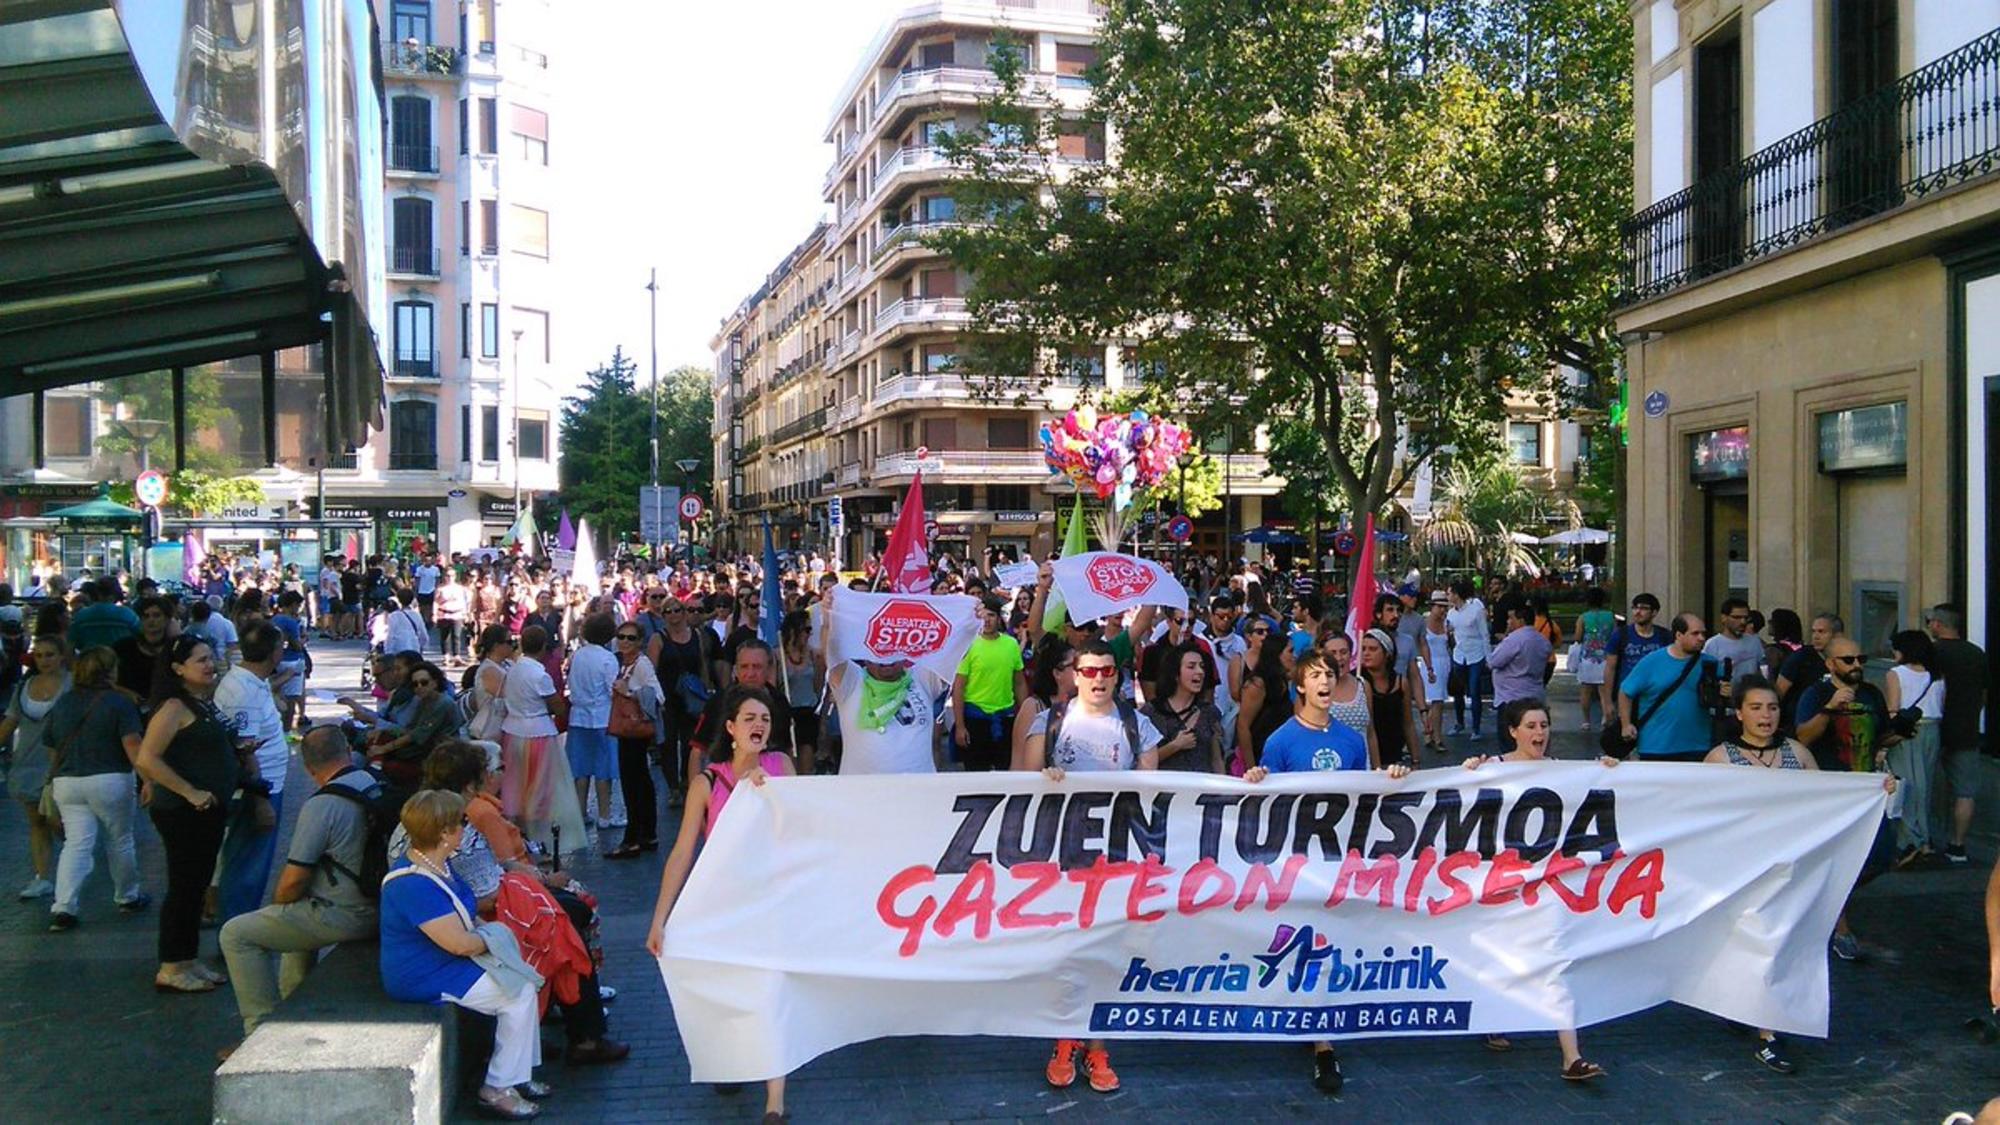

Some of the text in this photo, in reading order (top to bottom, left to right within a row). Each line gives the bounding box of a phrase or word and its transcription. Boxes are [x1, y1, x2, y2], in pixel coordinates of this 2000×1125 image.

[877, 627, 940, 646] STOP
[880, 617, 941, 630] KALERATZEAK
[935, 788, 1622, 875] ZUEN TURISMOA
[876, 852, 1307, 957] GAZTEON
[1119, 945, 1449, 993] herria bizirik
[1106, 1007, 1457, 1029] POSTALEN ATZEAN BAGARA
